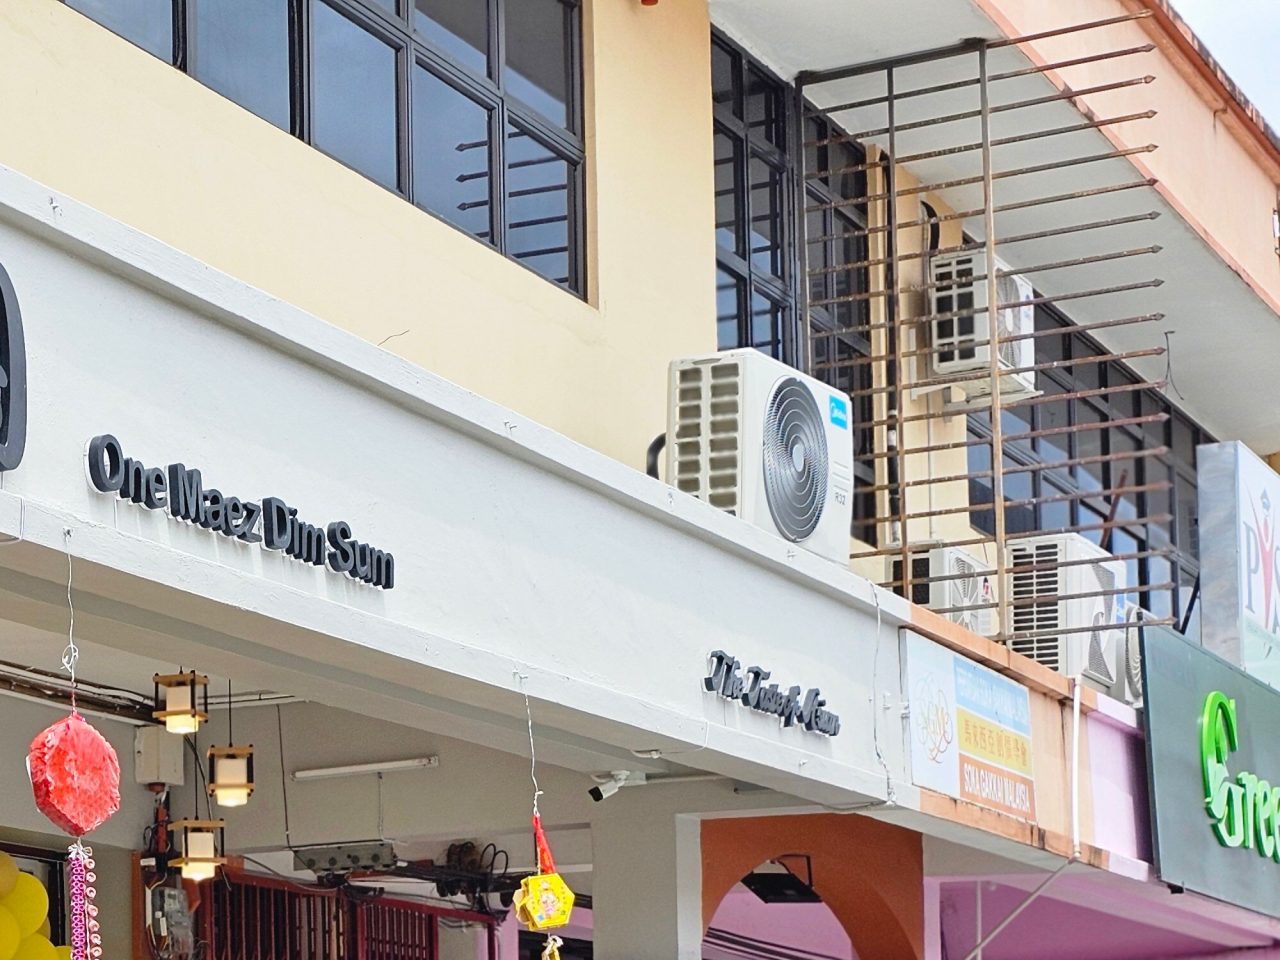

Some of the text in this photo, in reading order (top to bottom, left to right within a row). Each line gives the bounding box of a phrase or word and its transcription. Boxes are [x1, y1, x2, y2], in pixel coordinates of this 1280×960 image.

[88, 434, 395, 590] One Maez Dim Sum
[704, 650, 744, 699] The
[964, 763, 1030, 813] SOKA GAKKAI MALAYSIA
